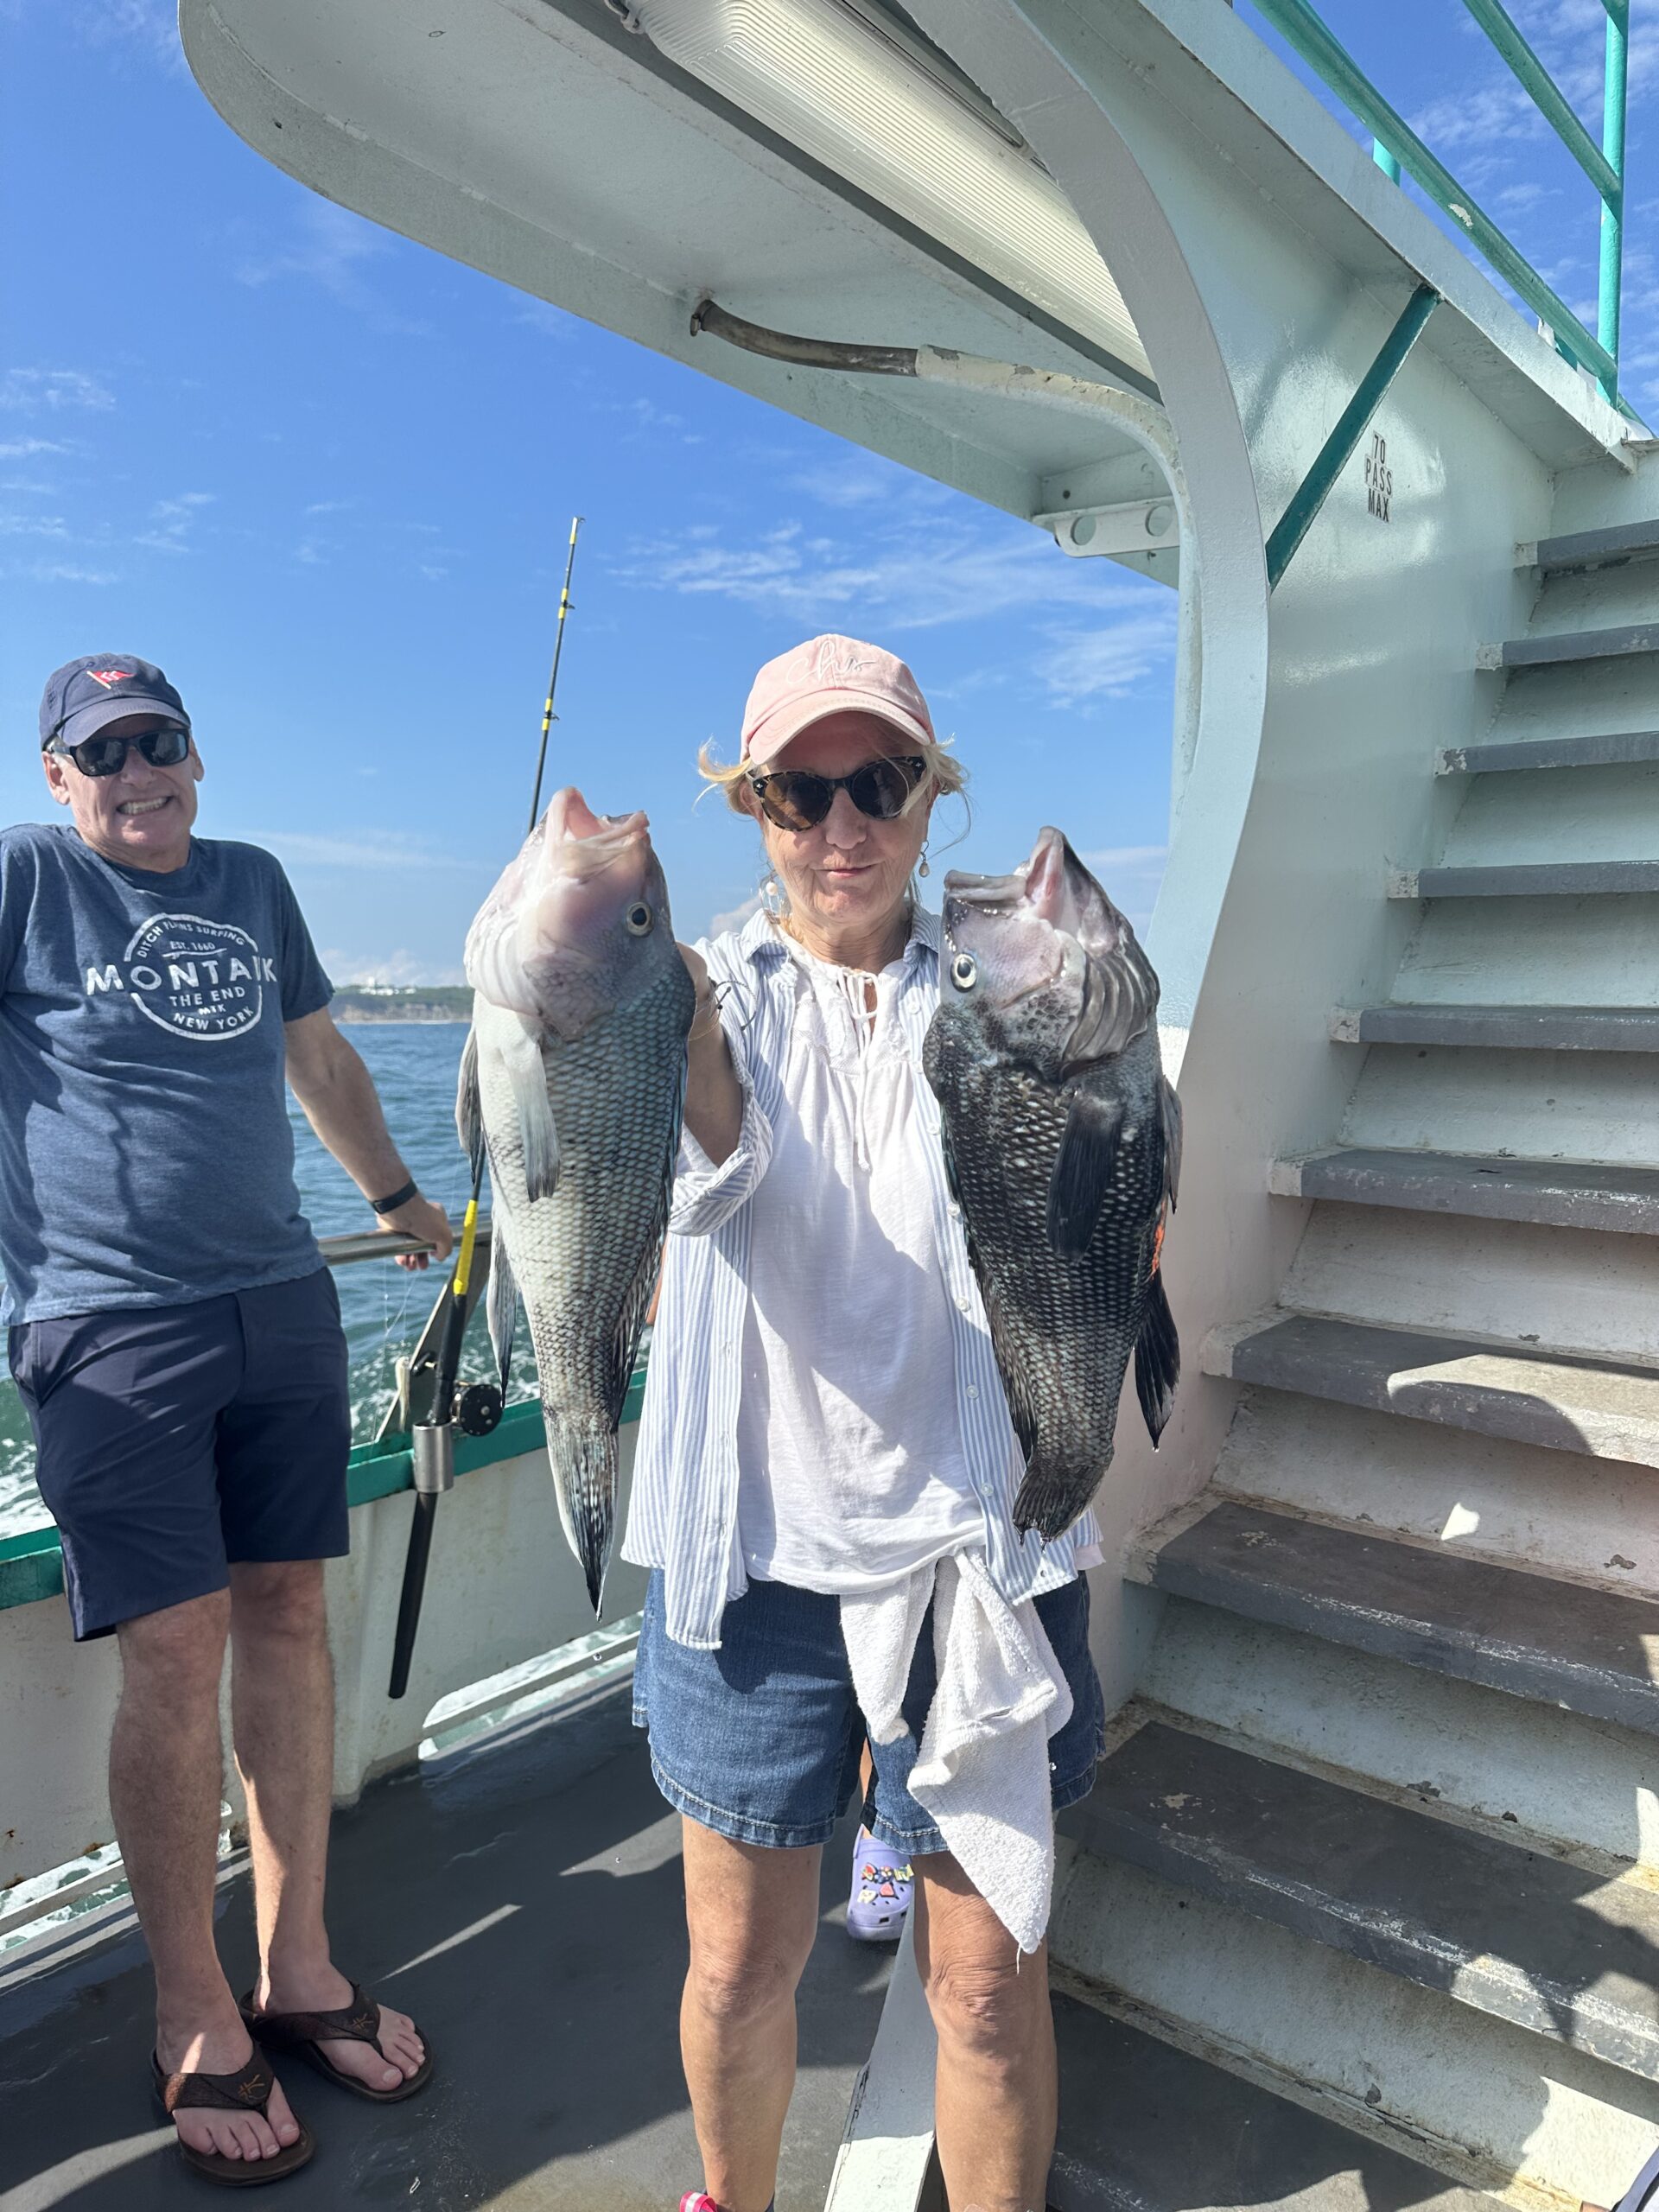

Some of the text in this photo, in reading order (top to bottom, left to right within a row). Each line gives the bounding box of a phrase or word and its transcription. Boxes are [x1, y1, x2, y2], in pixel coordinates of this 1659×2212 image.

[1366, 458, 1392, 496] PASS
[1368, 487, 1389, 523] MAX
[137, 925, 163, 958] DITCH
[196, 925, 245, 945] SURFING
[169, 940, 190, 950] EST.
[169, 986, 245, 1007] THE END
[174, 1006, 253, 1030] NEW YORK
[198, 1003, 226, 1015] MTK
